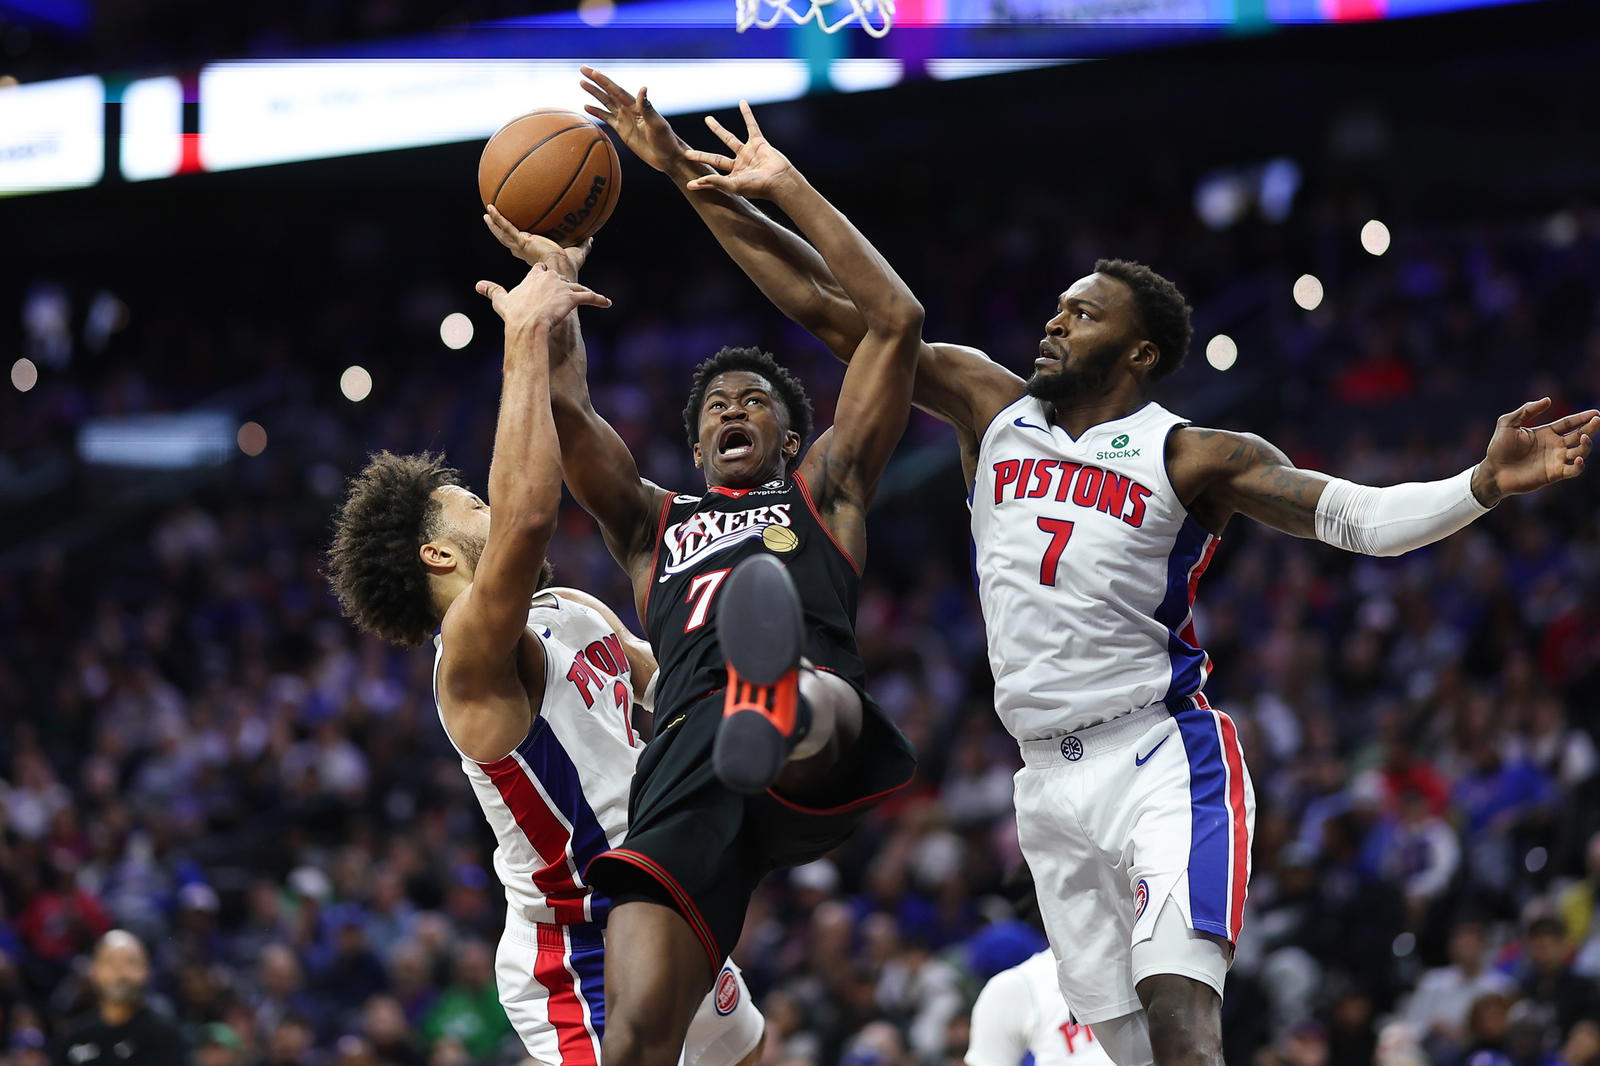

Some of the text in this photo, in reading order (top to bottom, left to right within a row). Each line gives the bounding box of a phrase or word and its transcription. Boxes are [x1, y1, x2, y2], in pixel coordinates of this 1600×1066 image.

[1096, 448, 1141, 460] StockX
[748, 482, 795, 496] crypto.co
[993, 458, 1152, 529] PISTONS
[659, 503, 792, 583] SIXERS
[1036, 516, 1075, 587] 7
[684, 567, 733, 634] 7
